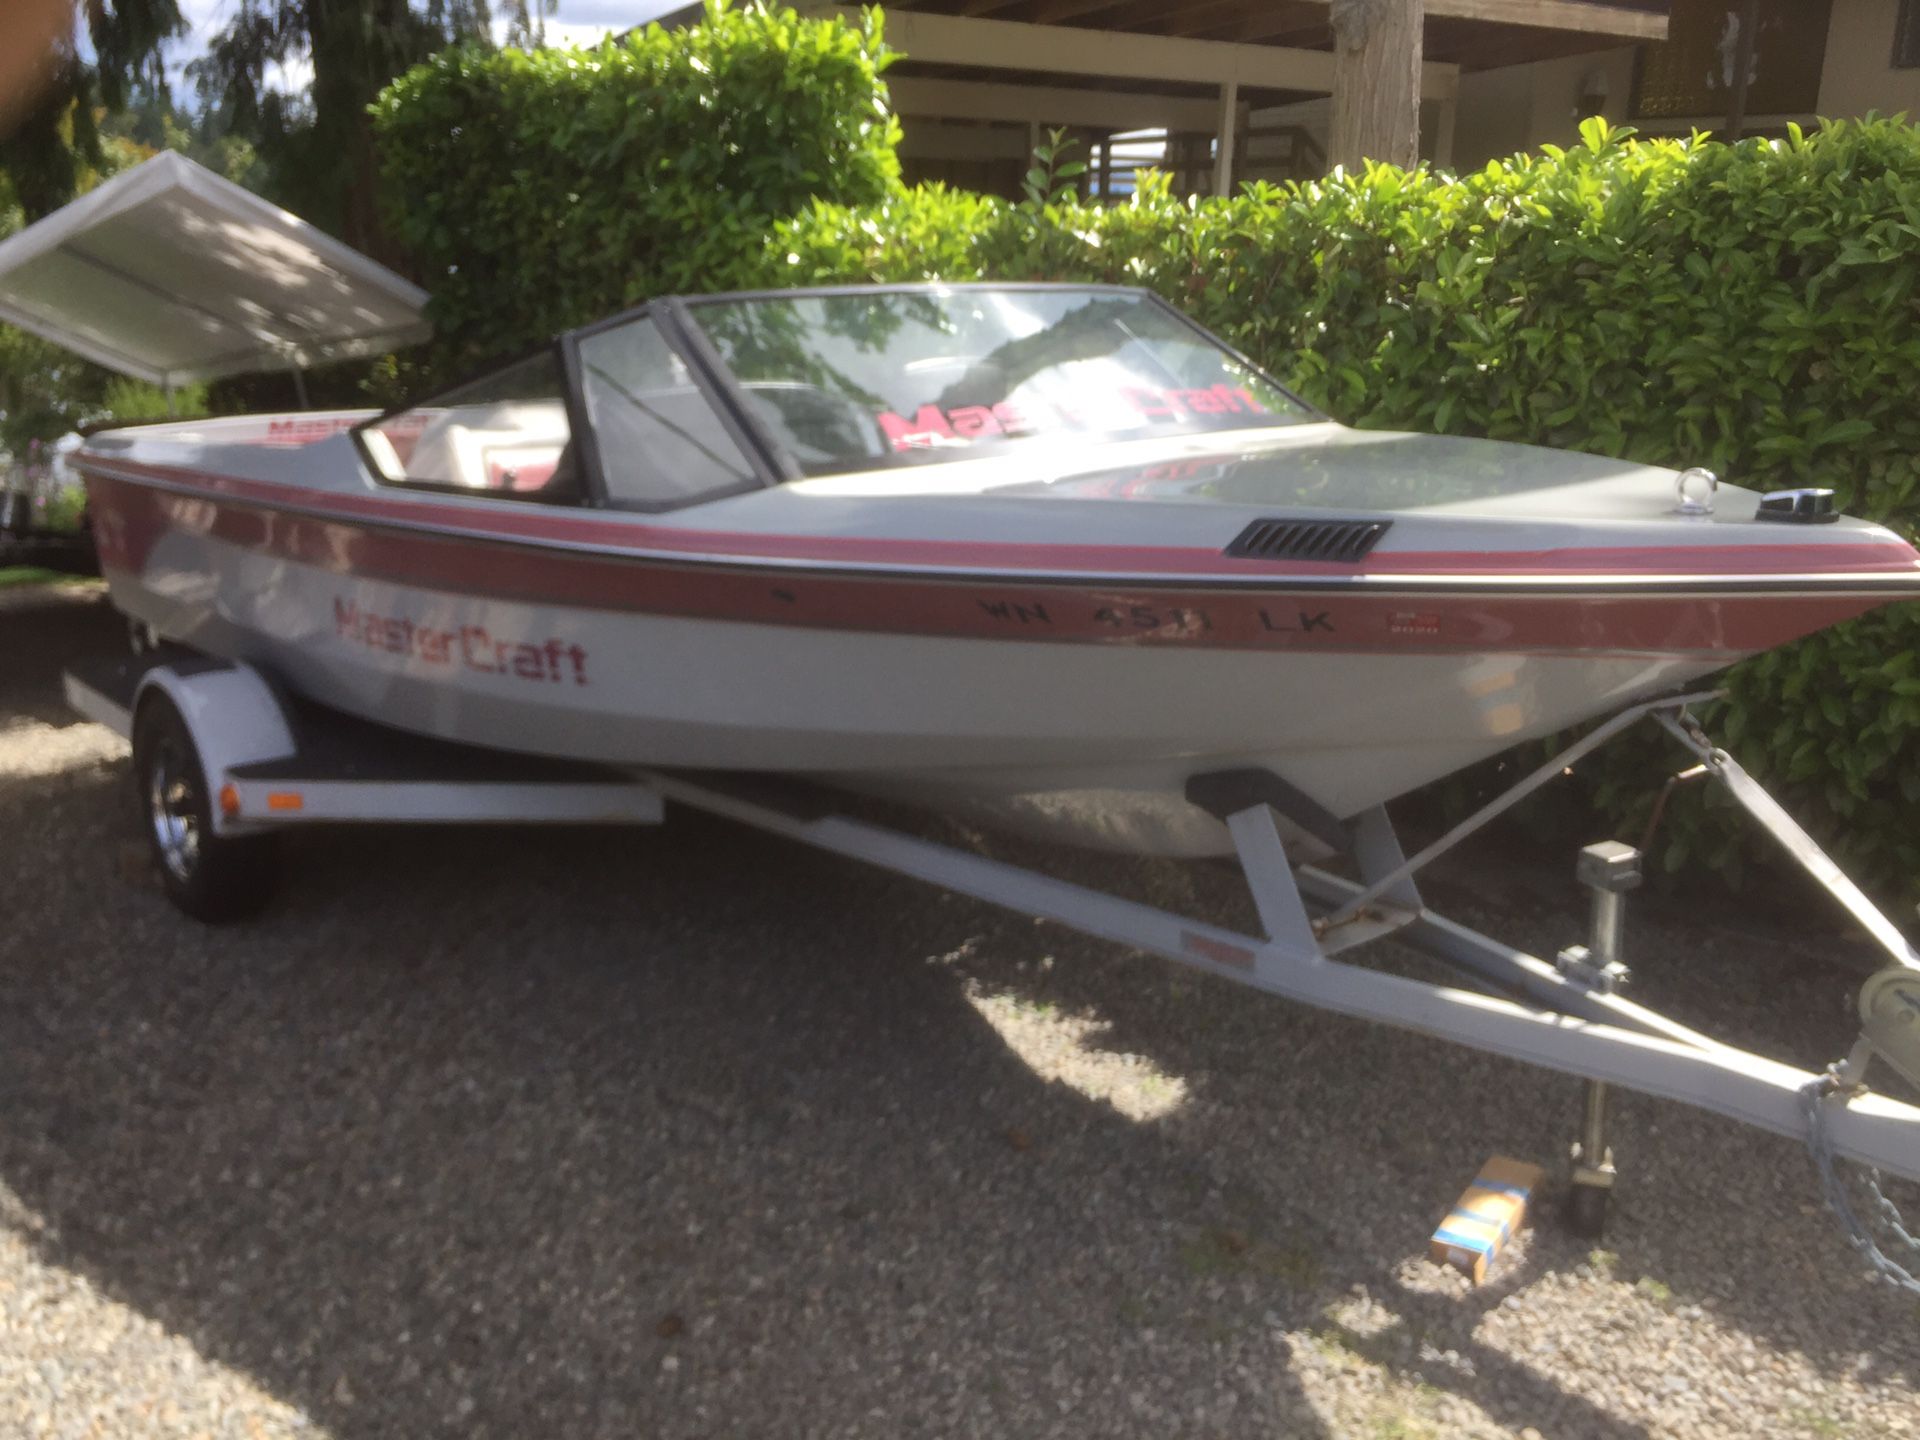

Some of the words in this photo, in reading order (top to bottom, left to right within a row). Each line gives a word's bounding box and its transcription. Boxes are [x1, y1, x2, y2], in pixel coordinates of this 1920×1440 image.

[334, 595, 588, 687] MasterCraft
[976, 600, 1053, 624] WN
[1258, 607, 1335, 633] LK
